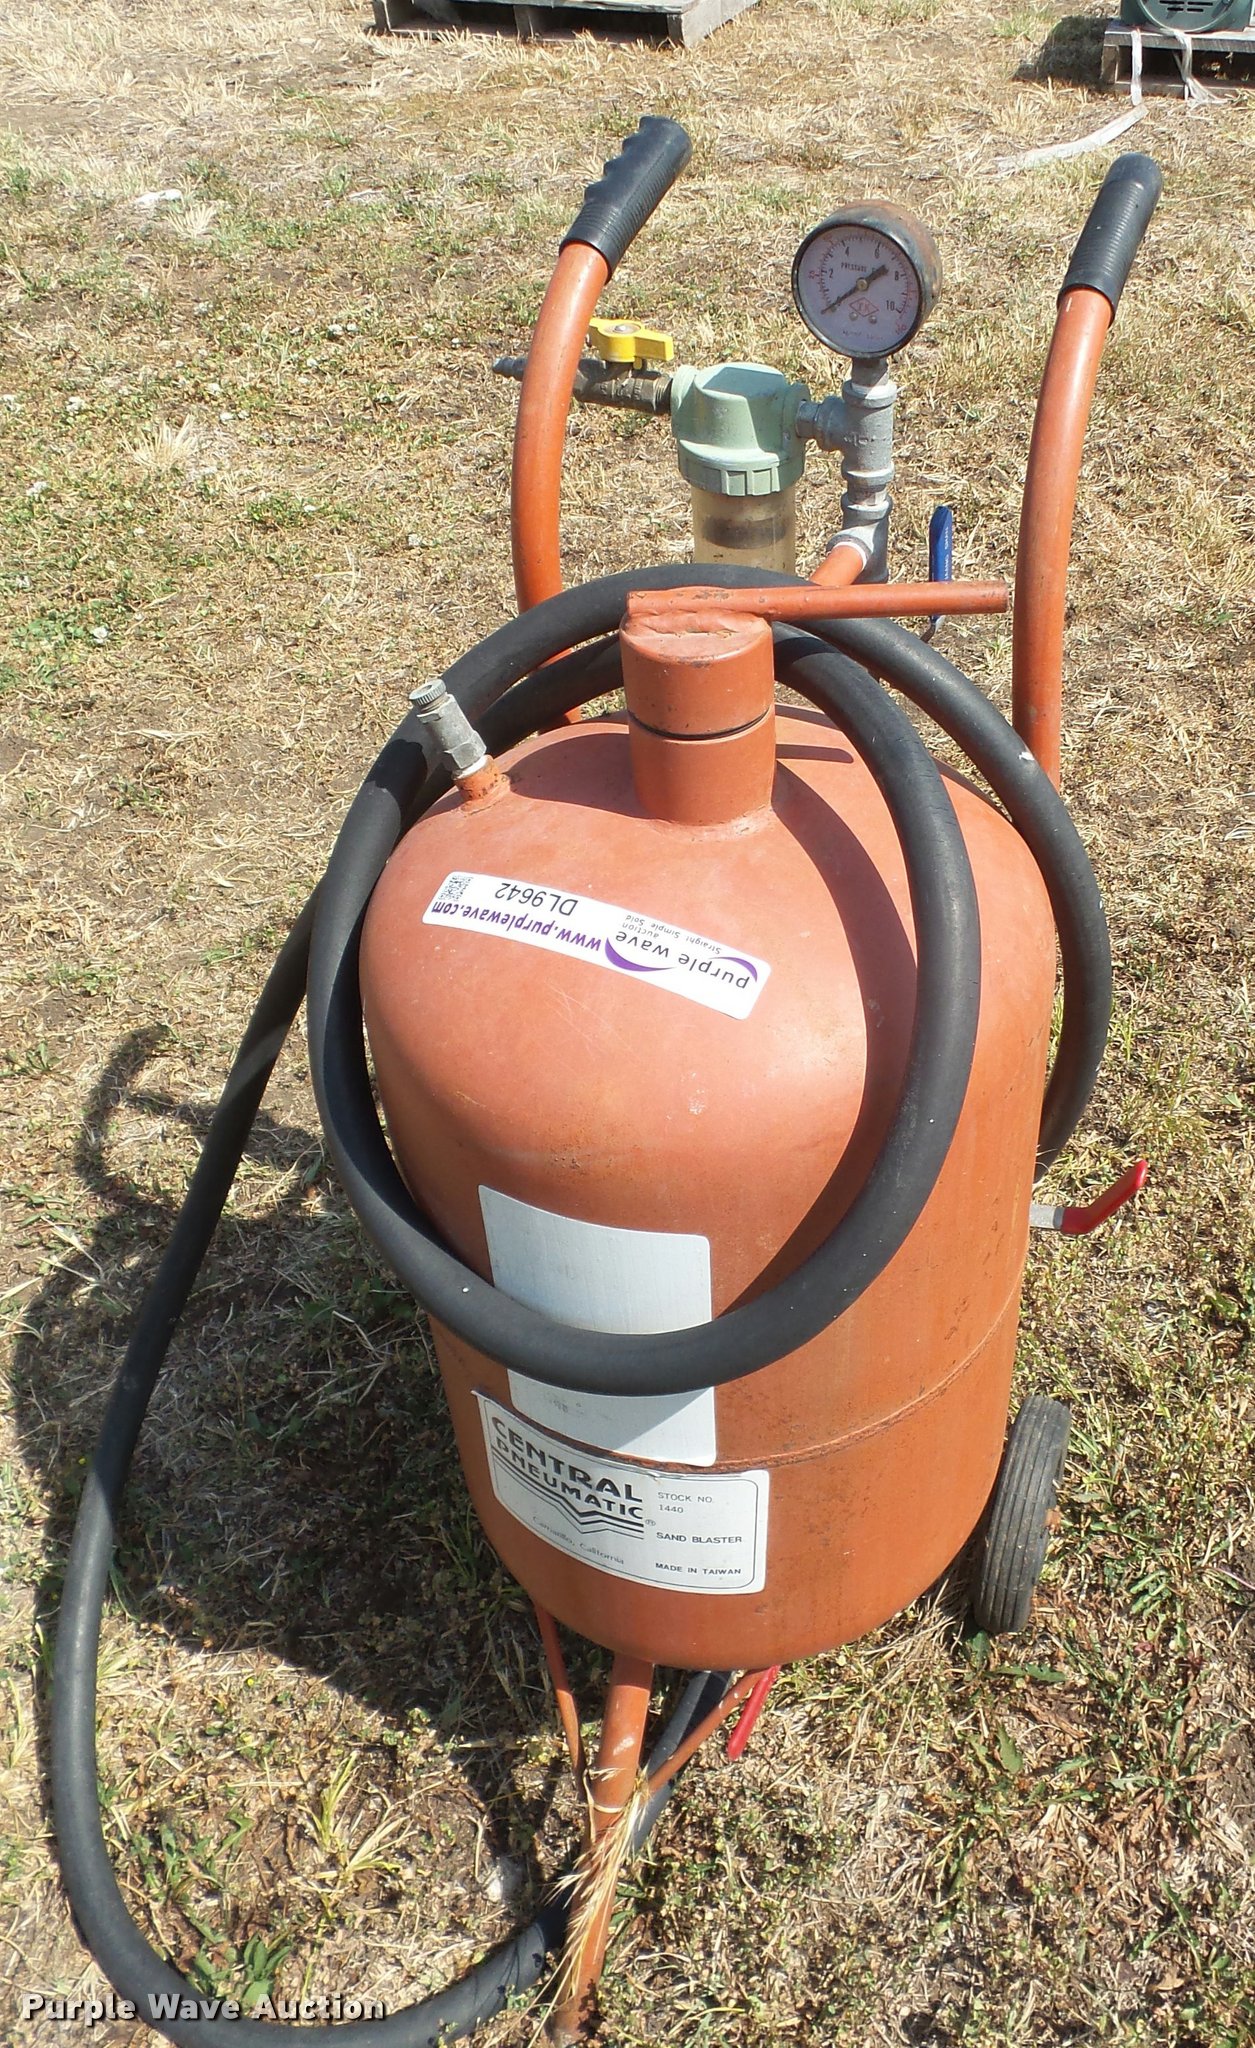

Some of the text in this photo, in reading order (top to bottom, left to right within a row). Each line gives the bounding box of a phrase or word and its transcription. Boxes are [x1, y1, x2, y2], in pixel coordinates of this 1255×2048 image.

[886, 300, 895, 311] 10
[494, 881, 579, 916] DL9642
[431, 901, 602, 953] www.purplewave.com
[621, 922, 660, 939] auction
[614, 930, 750, 989] purple wave
[492, 1417, 643, 1503] CENTRAL
[496, 1436, 644, 1519] PNEUMATIC
[657, 1492, 692, 1503] STOCK
[658, 1504, 684, 1514] 1440
[656, 1531, 742, 1544] SAND BLASTER
[655, 1562, 682, 1573] MADE
